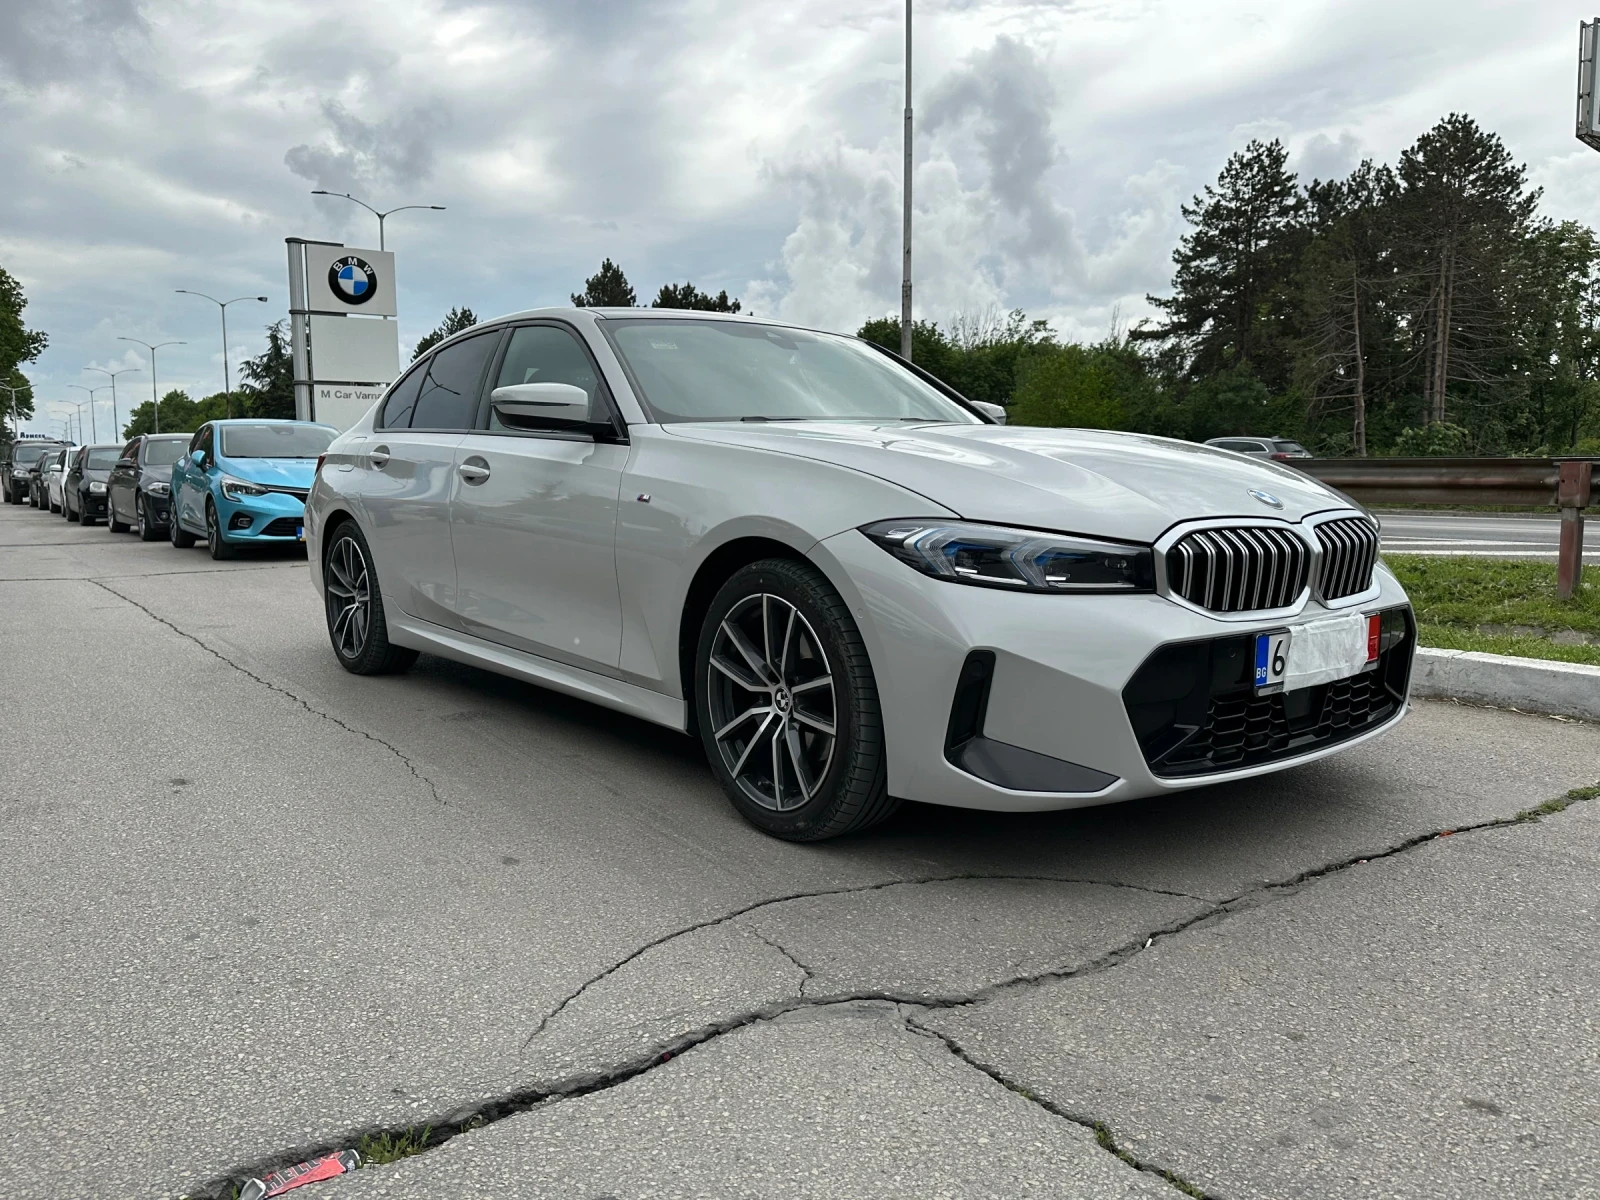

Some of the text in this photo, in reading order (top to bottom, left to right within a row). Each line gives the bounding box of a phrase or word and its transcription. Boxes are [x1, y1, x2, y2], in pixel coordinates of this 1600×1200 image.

[333, 257, 374, 275] BMW
[321, 390, 331, 399] M
[334, 390, 352, 399] Car
[1272, 639, 1285, 677] 6
[1256, 667, 1267, 679] BG
